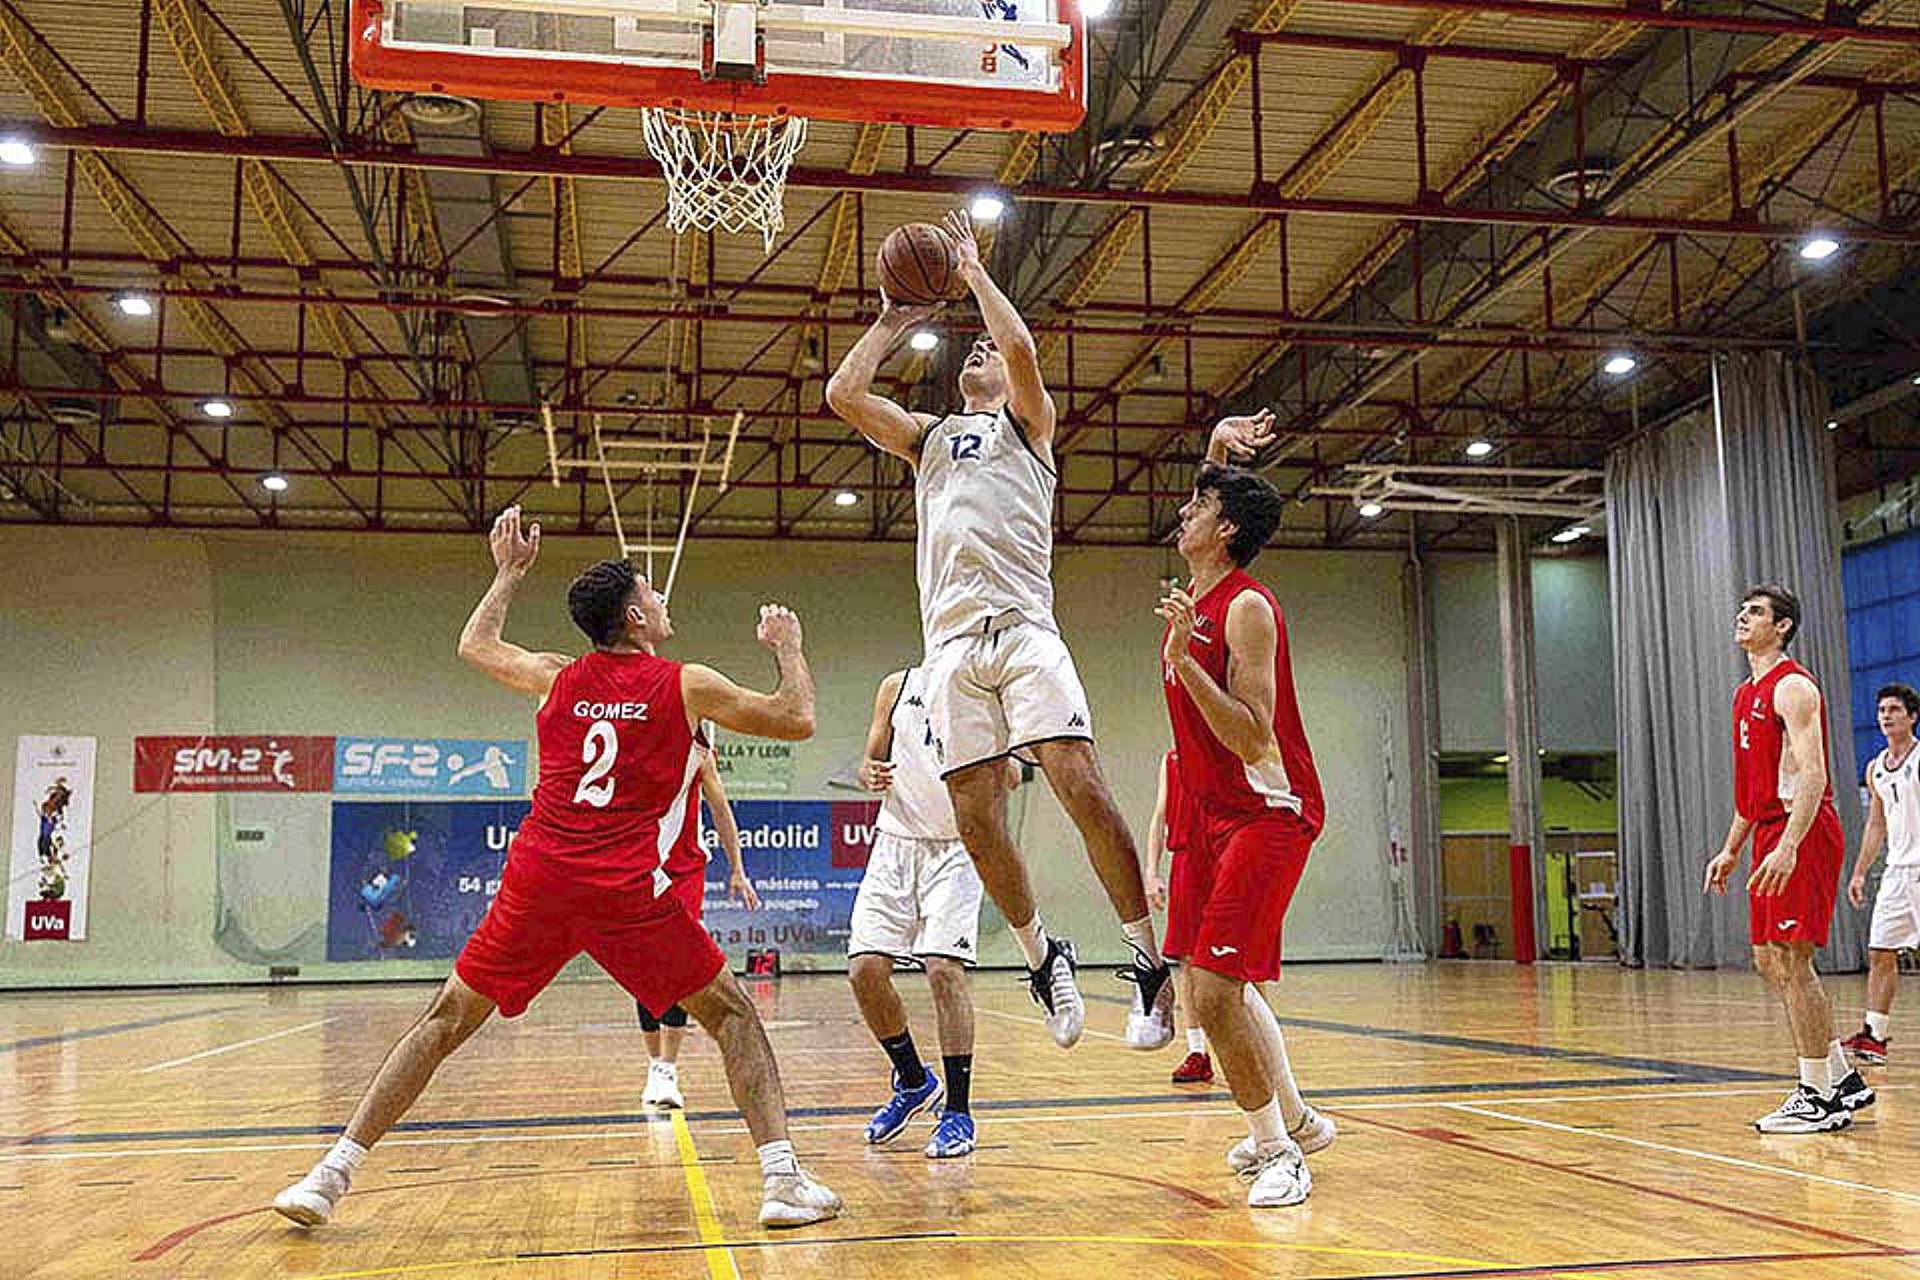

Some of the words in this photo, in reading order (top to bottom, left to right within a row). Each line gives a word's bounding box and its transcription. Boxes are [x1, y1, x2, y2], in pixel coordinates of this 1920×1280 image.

[949, 433, 982, 461] 12
[573, 701, 648, 720] GOMEZ
[573, 720, 618, 807] 2
[1890, 783, 1900, 803] 1
[843, 824, 875, 845] UV
[459, 877, 480, 893] 54
[31, 915, 64, 930] UVa
[729, 930, 741, 944] a
[749, 927, 766, 943] la
